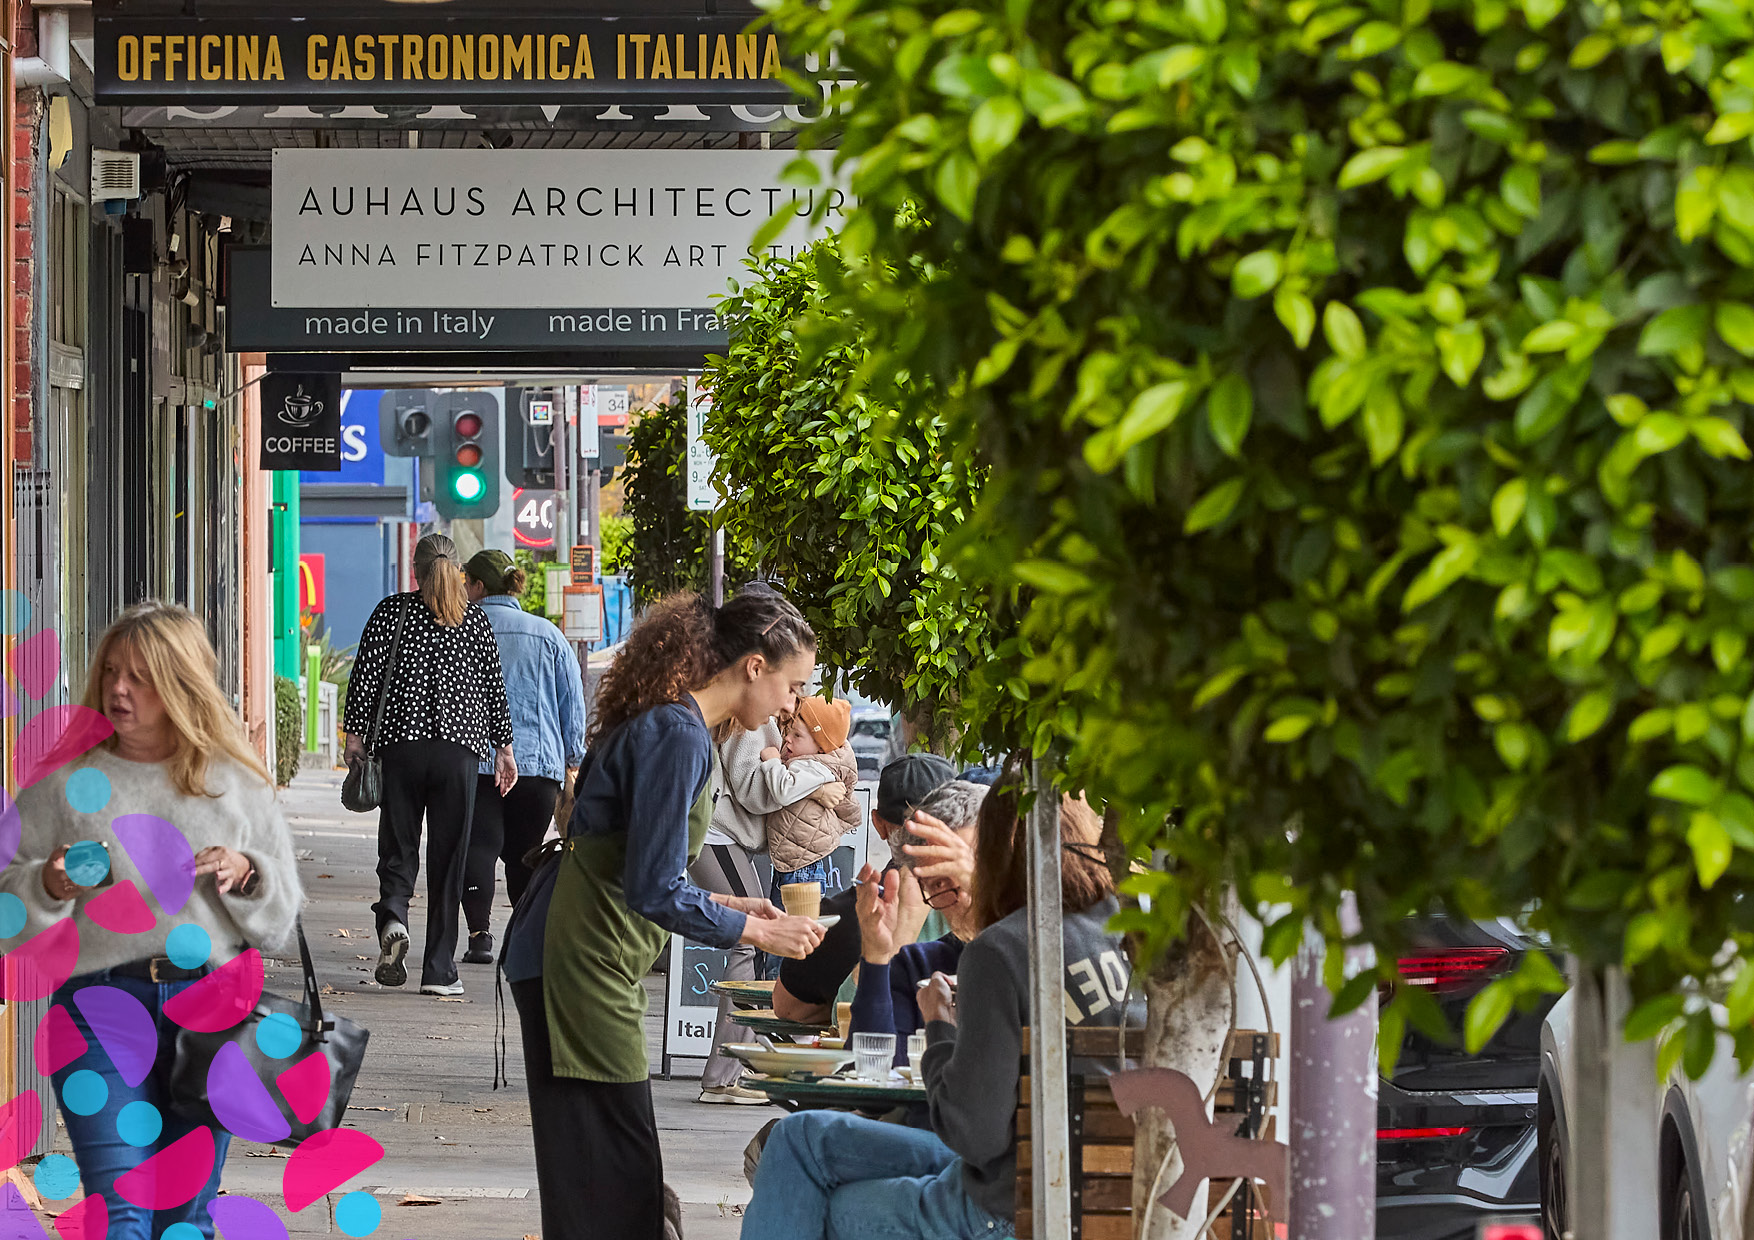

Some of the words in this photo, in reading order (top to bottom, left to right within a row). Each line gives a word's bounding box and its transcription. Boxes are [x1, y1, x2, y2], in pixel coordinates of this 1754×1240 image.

[117, 34, 285, 81] OFFICINA
[307, 33, 595, 81] GASTRONOMICA
[617, 33, 783, 80] ITALIANA
[298, 187, 485, 217] AUHAUS
[511, 187, 864, 218] ARCHITECTUR
[298, 243, 396, 266] ANNA
[417, 243, 644, 267] FITZPATRICK
[663, 244, 727, 267] ART
[305, 310, 388, 334] made
[397, 311, 422, 334] in
[433, 310, 495, 340] Italy
[549, 310, 632, 333] made
[641, 310, 667, 332] in
[608, 399, 625, 412] 34
[265, 436, 336, 455] COFFEE
[677, 1020, 716, 1039] Ital
